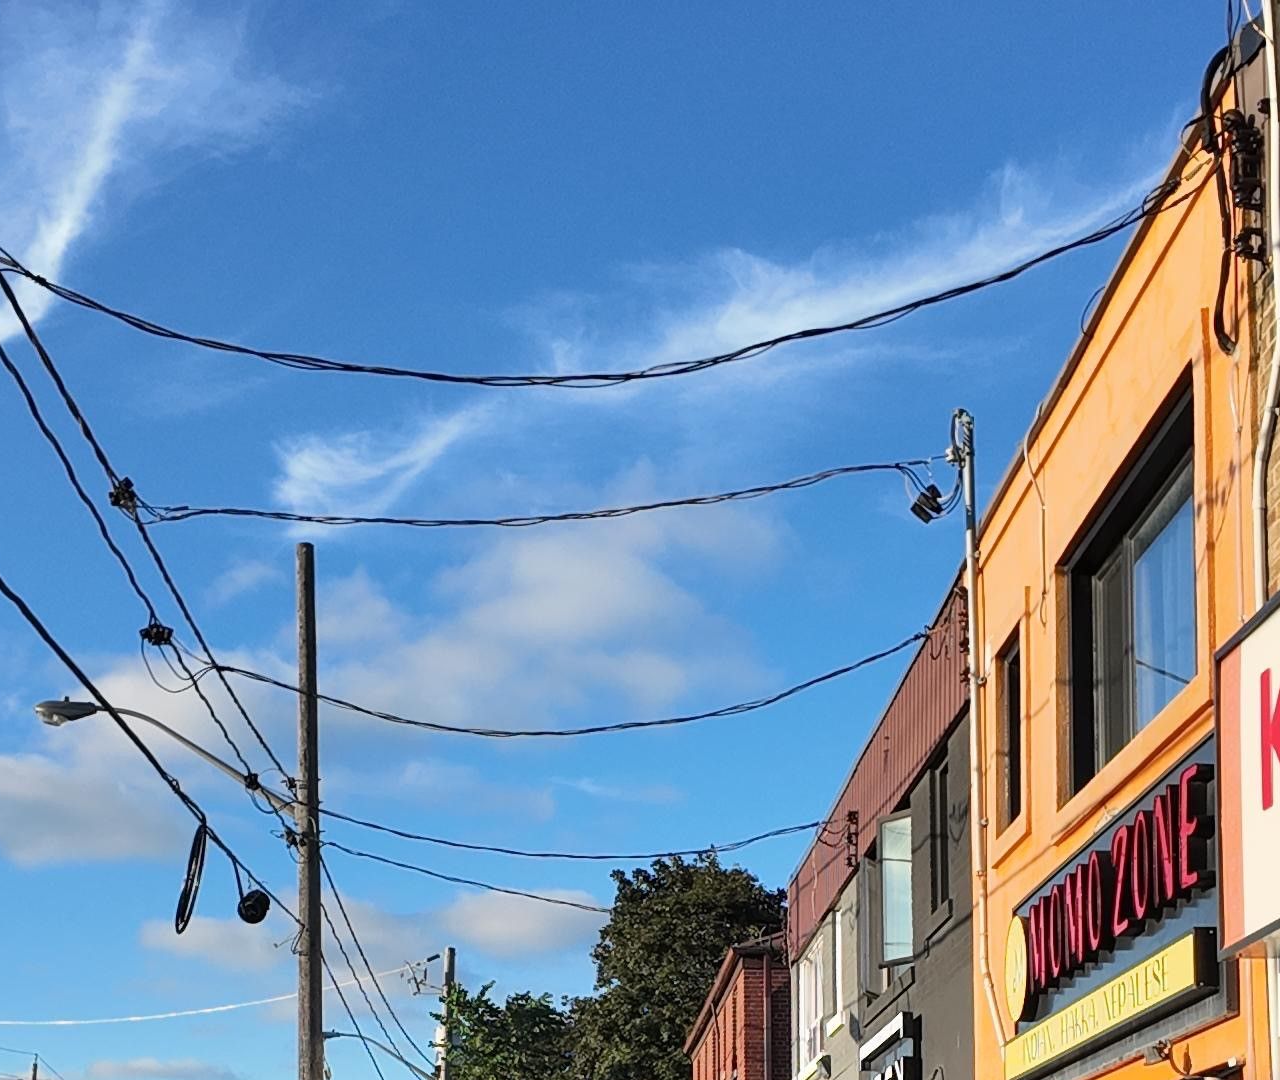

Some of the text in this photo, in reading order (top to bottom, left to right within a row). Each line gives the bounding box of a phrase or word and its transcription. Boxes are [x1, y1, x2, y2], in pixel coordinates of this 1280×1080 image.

[1028, 763, 1199, 995] MOMO ZONE
[1104, 953, 1170, 1021] NEPALESE
